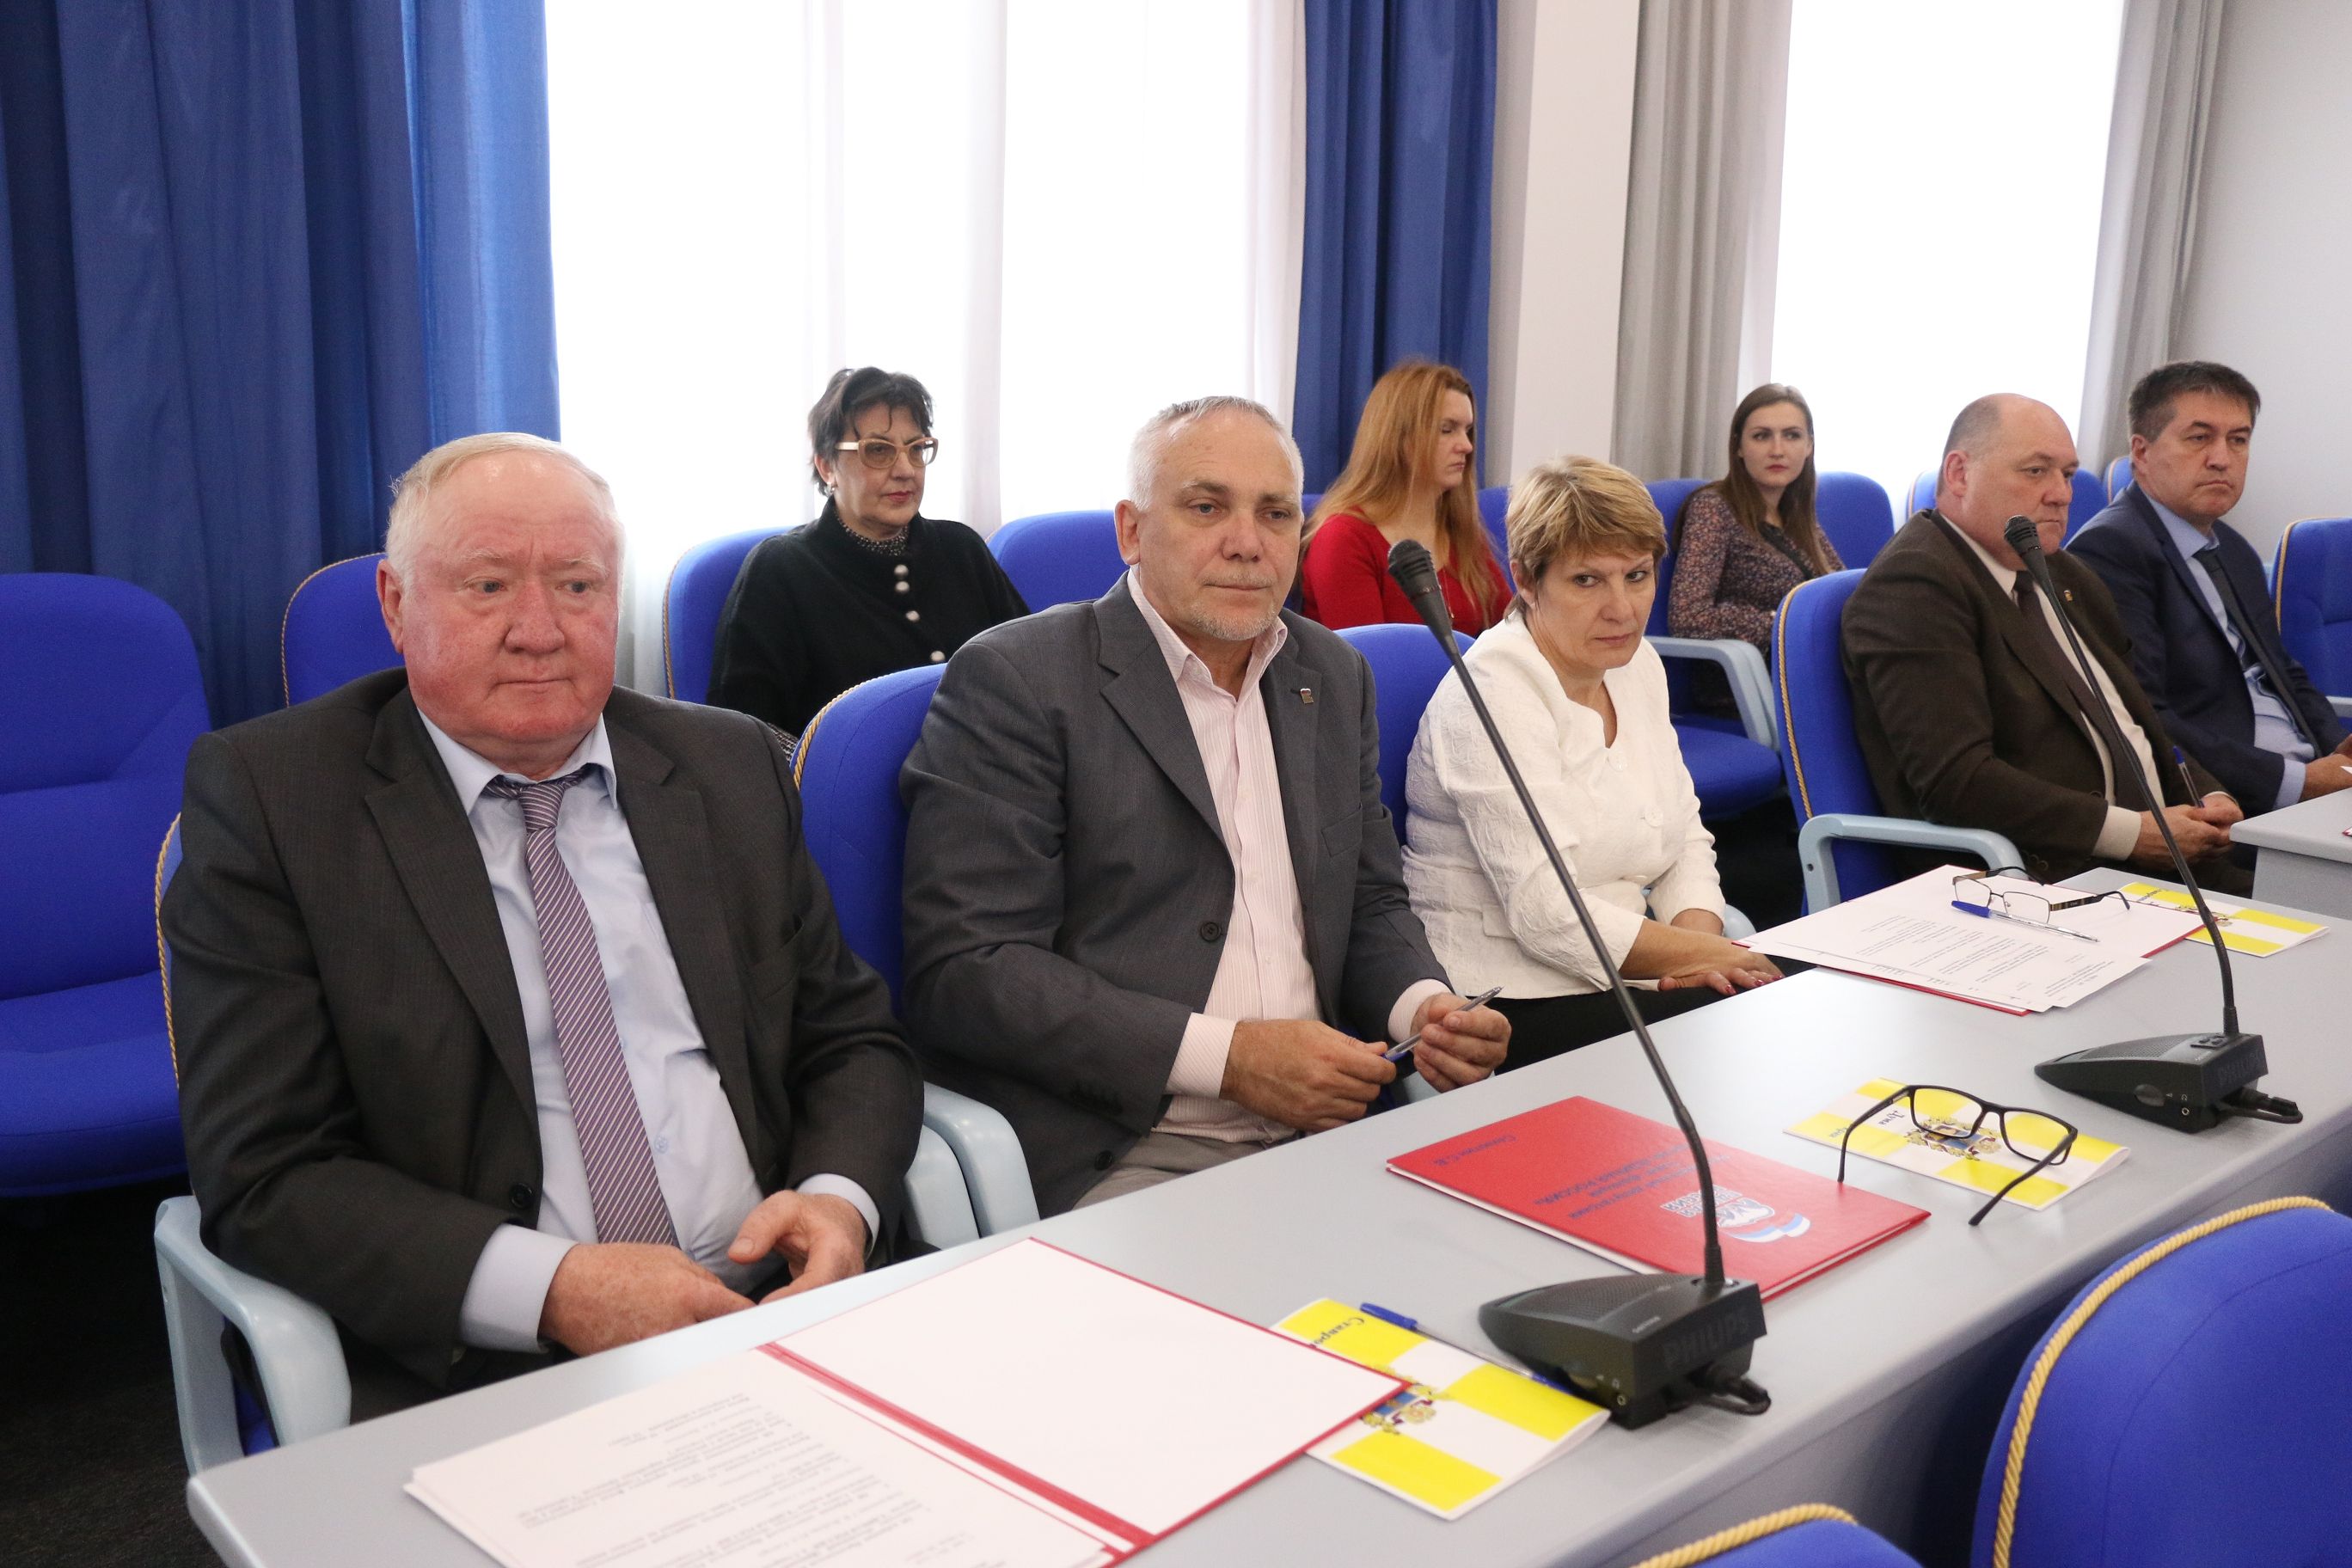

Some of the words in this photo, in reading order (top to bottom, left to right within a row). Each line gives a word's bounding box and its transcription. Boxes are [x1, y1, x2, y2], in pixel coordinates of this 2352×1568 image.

[1877, 1110, 1905, 1125] Дума
[1308, 1317, 1364, 1349] Ставро
[1663, 1309, 1750, 1369] PHILIPS
